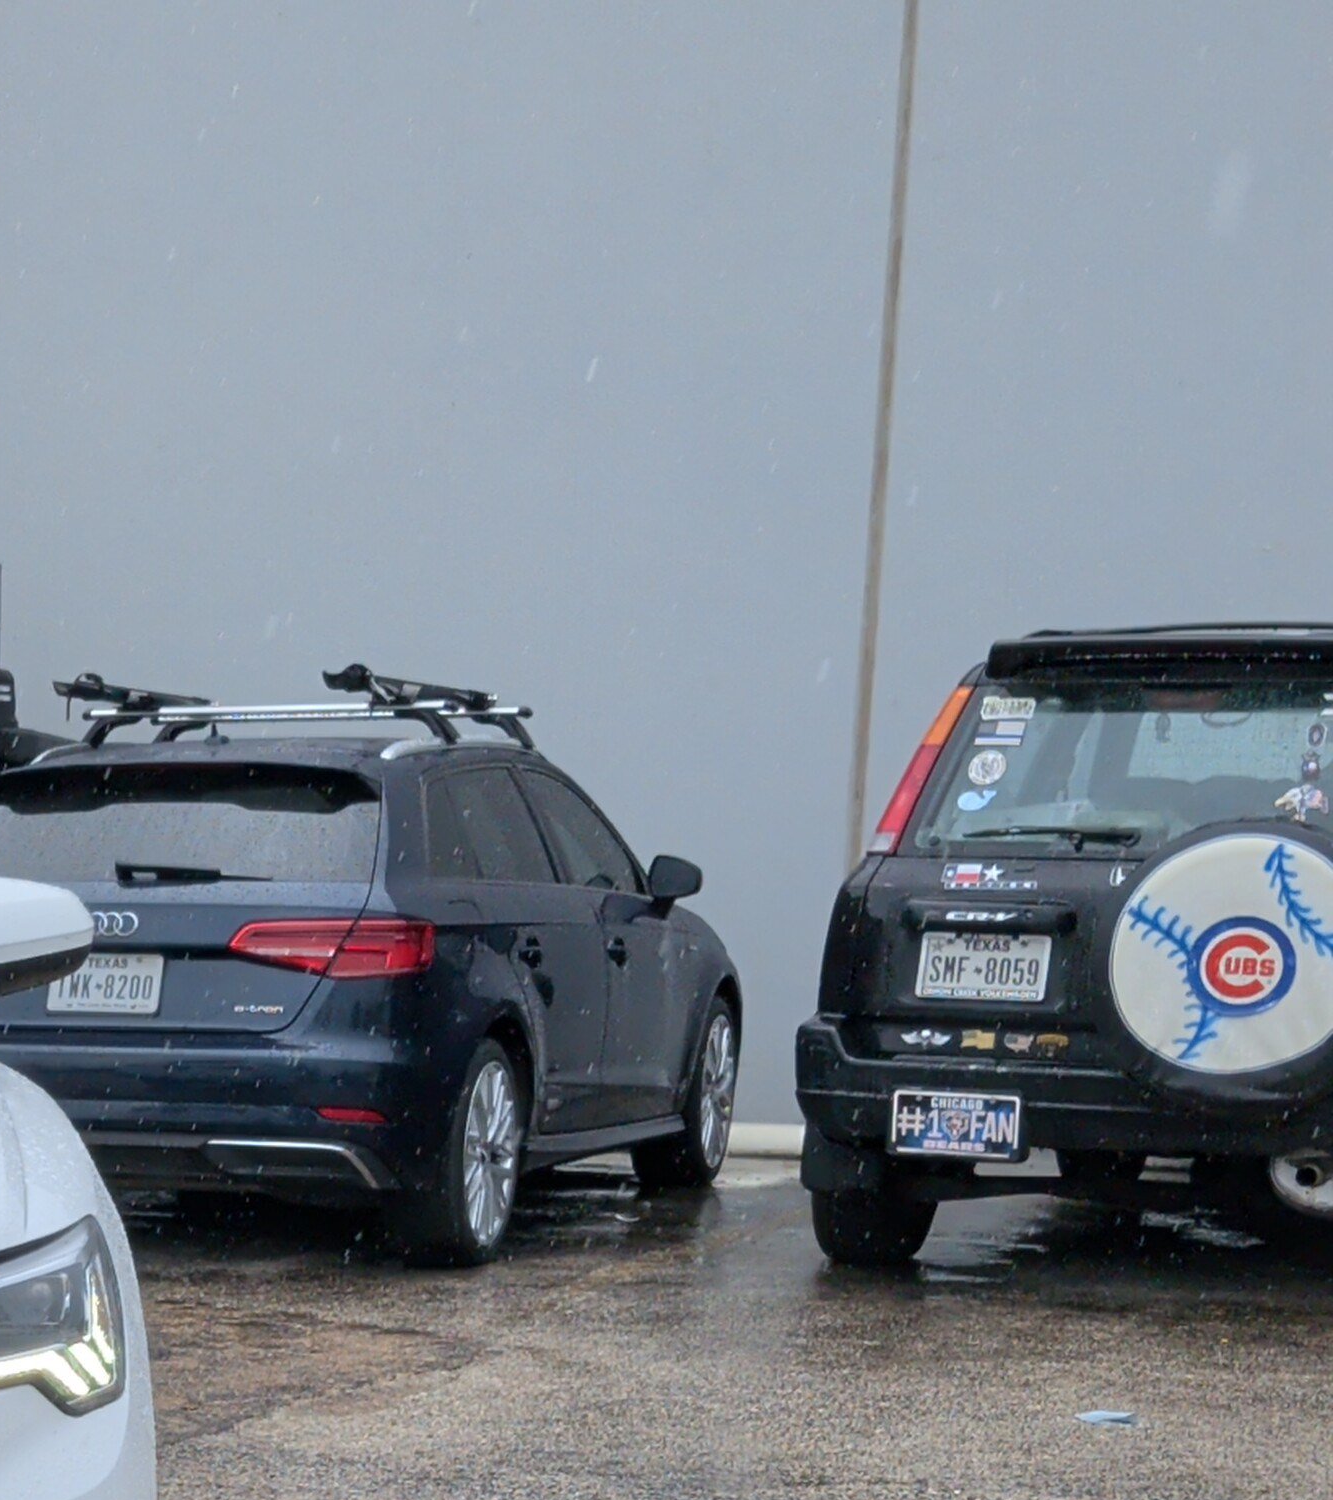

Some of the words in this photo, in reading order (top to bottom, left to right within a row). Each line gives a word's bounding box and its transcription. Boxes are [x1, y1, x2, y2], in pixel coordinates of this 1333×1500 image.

[963, 936, 1011, 952] TEXAS
[87, 957, 129, 969] TEXAS
[984, 957, 1040, 986] 8059
[1205, 934, 1275, 998] CUBS
[102, 974, 153, 1000] 8200
[930, 1097, 984, 1110] CHICAGO
[969, 1110, 1014, 1144] FAN
[922, 1139, 985, 1152] BEARS
